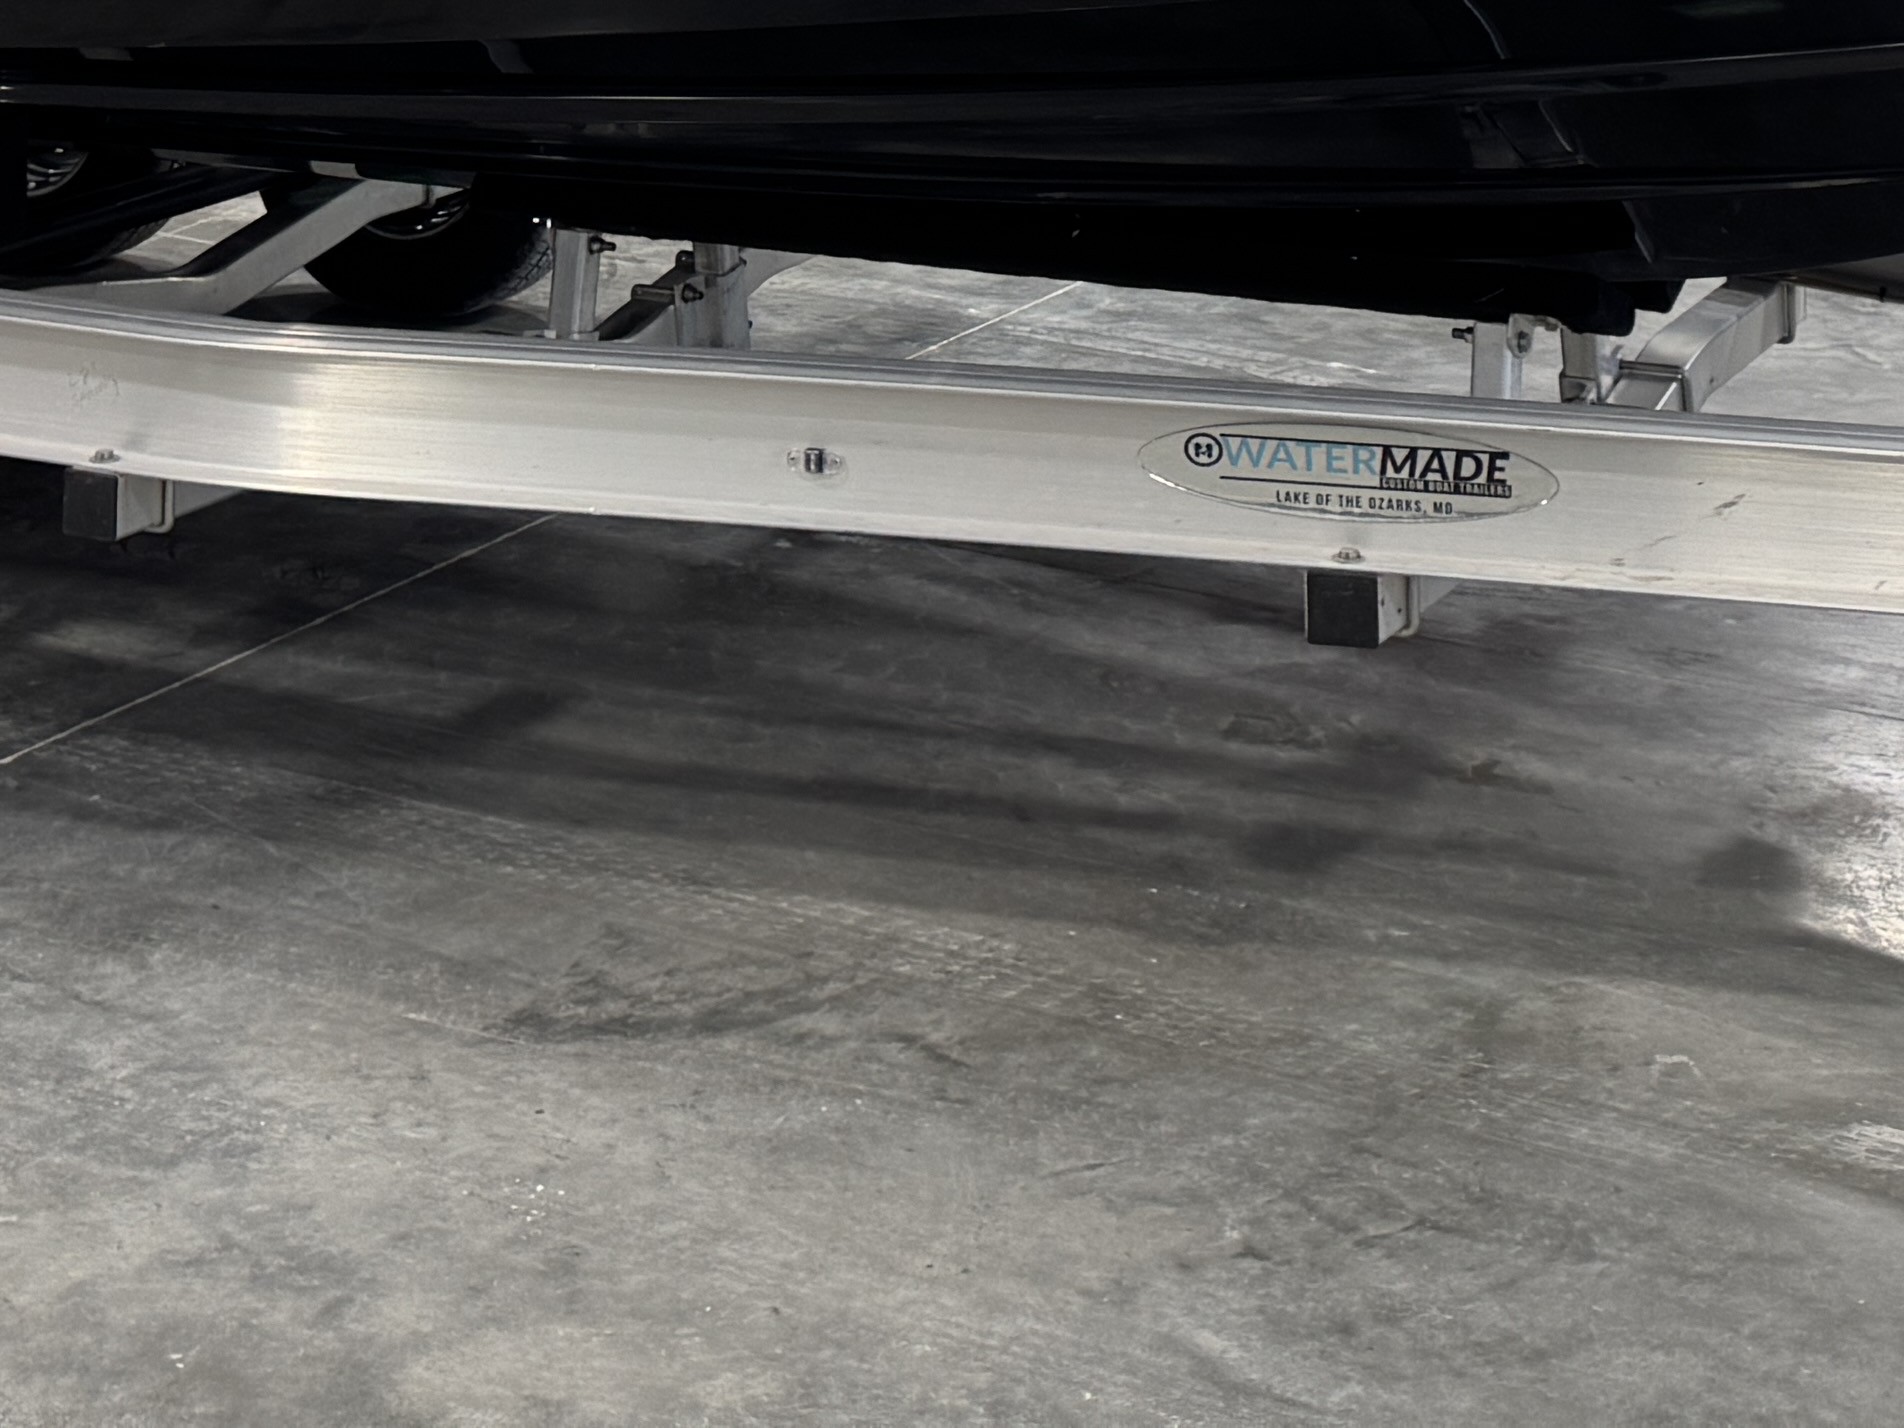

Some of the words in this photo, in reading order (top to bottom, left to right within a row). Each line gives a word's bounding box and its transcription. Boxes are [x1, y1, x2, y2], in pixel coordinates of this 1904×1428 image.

[1382, 478, 1424, 491] CUSTOM
[1428, 482, 1455, 493] BOAT
[1459, 484, 1509, 497] TRAILERS
[1276, 490, 1310, 505] LAKE
[1316, 494, 1332, 506] OF
[1338, 494, 1362, 509] THE
[1368, 497, 1427, 515] OZARKS,
[1433, 501, 1454, 515] MO
